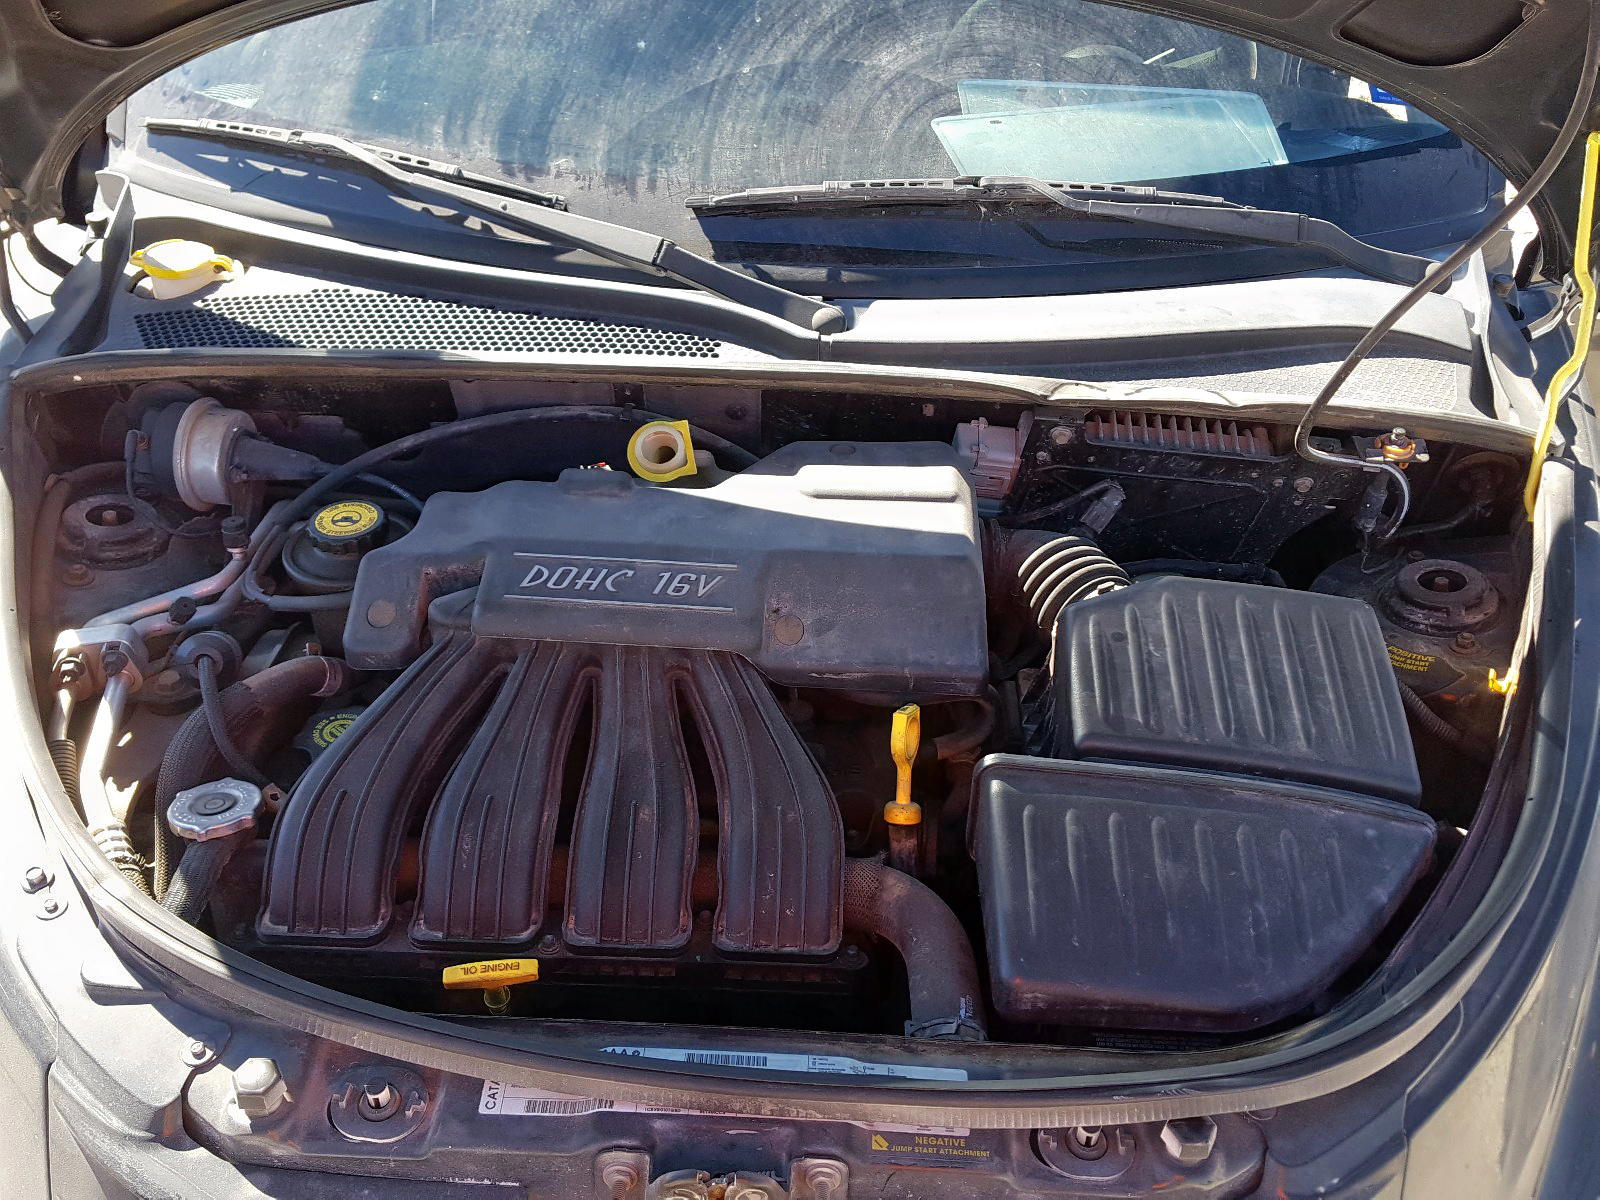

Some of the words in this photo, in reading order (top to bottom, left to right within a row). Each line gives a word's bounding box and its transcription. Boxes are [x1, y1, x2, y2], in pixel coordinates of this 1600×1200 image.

[519, 564, 635, 592] DOHC
[651, 571, 723, 598] 16V
[1387, 645, 1436, 662] POSITIVE
[460, 965, 478, 976] OIL
[479, 961, 520, 974] ENGINE
[915, 1135, 967, 1147] NEGATIVE
[891, 1144, 912, 1153] JUMP
[914, 1146, 937, 1154] START
[939, 1147, 991, 1158] ATTACHMENT
